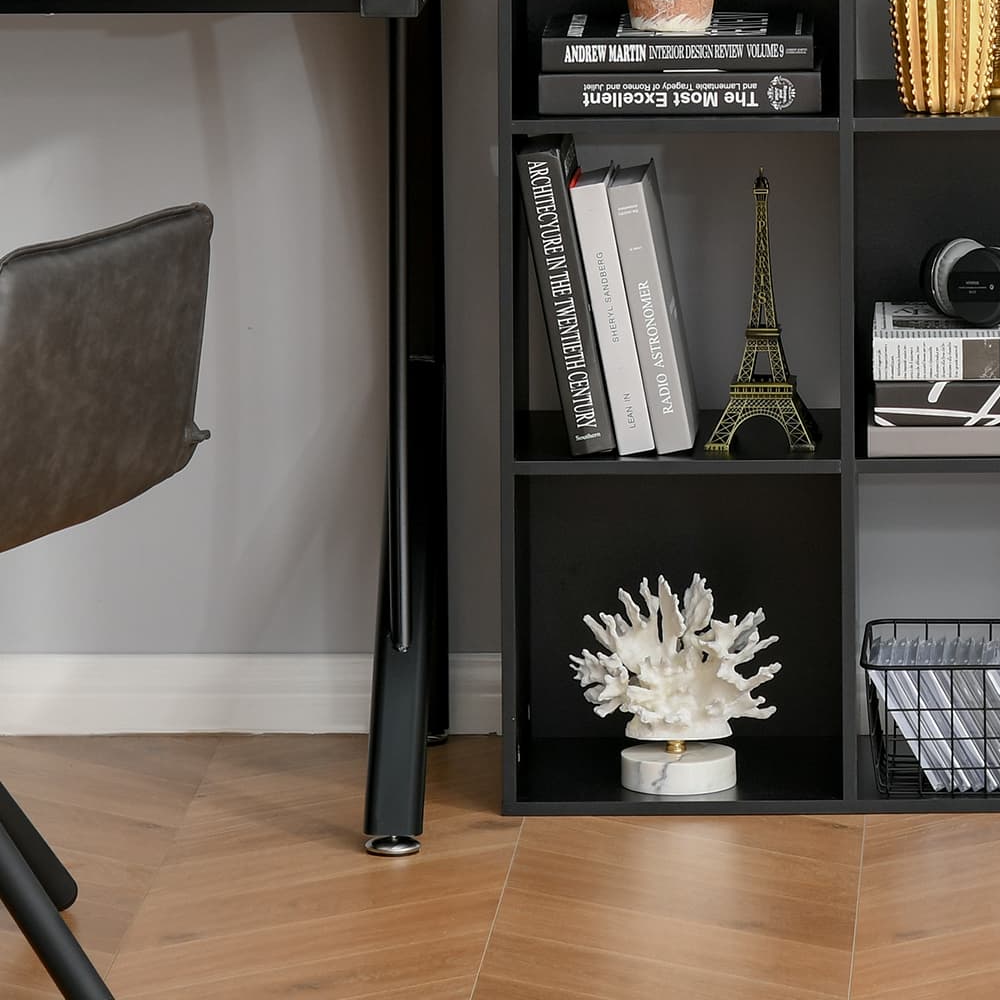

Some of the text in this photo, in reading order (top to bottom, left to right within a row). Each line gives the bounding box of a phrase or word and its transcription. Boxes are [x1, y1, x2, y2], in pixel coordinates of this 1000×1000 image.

[564, 44, 607, 63] ANDREW
[608, 44, 647, 63] MARTIN
[648, 44, 685, 60] INTERIOR
[685, 44, 714, 59] DESIGN
[714, 43, 744, 59] REVIEW
[746, 43, 779, 58] VOLUME
[779, 44, 785, 58] 9
[583, 81, 758, 92] and Lamentable Tragedy of Romeo and Juliet
[582, 91, 668, 108] Excellent
[673, 91, 718, 107] Most
[724, 91, 759, 107] The
[527, 161, 597, 428] ARCHITECYURE IN THE TWENTIETH CENTURY
[596, 252, 619, 343] SHERYL SANDBERG
[638, 280, 674, 415] RADIO ASTRONOMER
[623, 392, 636, 430] LEAN IN
